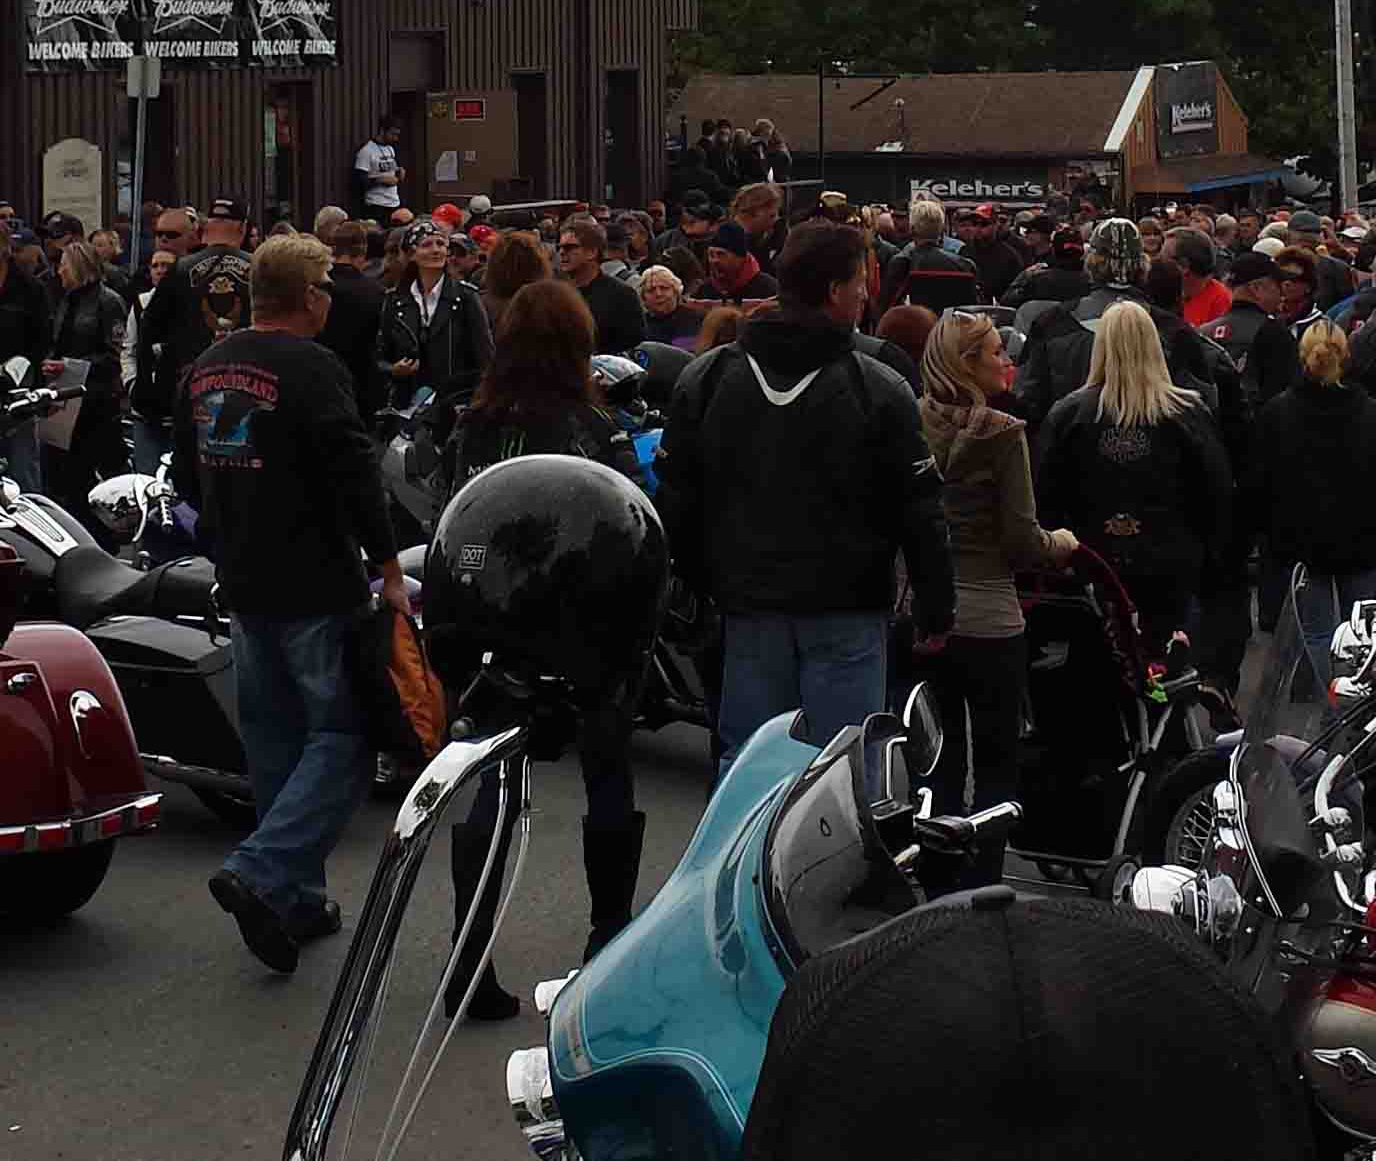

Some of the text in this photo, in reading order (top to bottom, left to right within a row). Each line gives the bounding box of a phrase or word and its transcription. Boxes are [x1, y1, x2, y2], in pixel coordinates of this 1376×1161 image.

[28, 41, 135, 60] WELCOME BIKERS
[144, 40, 239, 58] WELCOME BIKERS
[910, 179, 1043, 197] Keleher's
[464, 549, 482, 560] DOT
